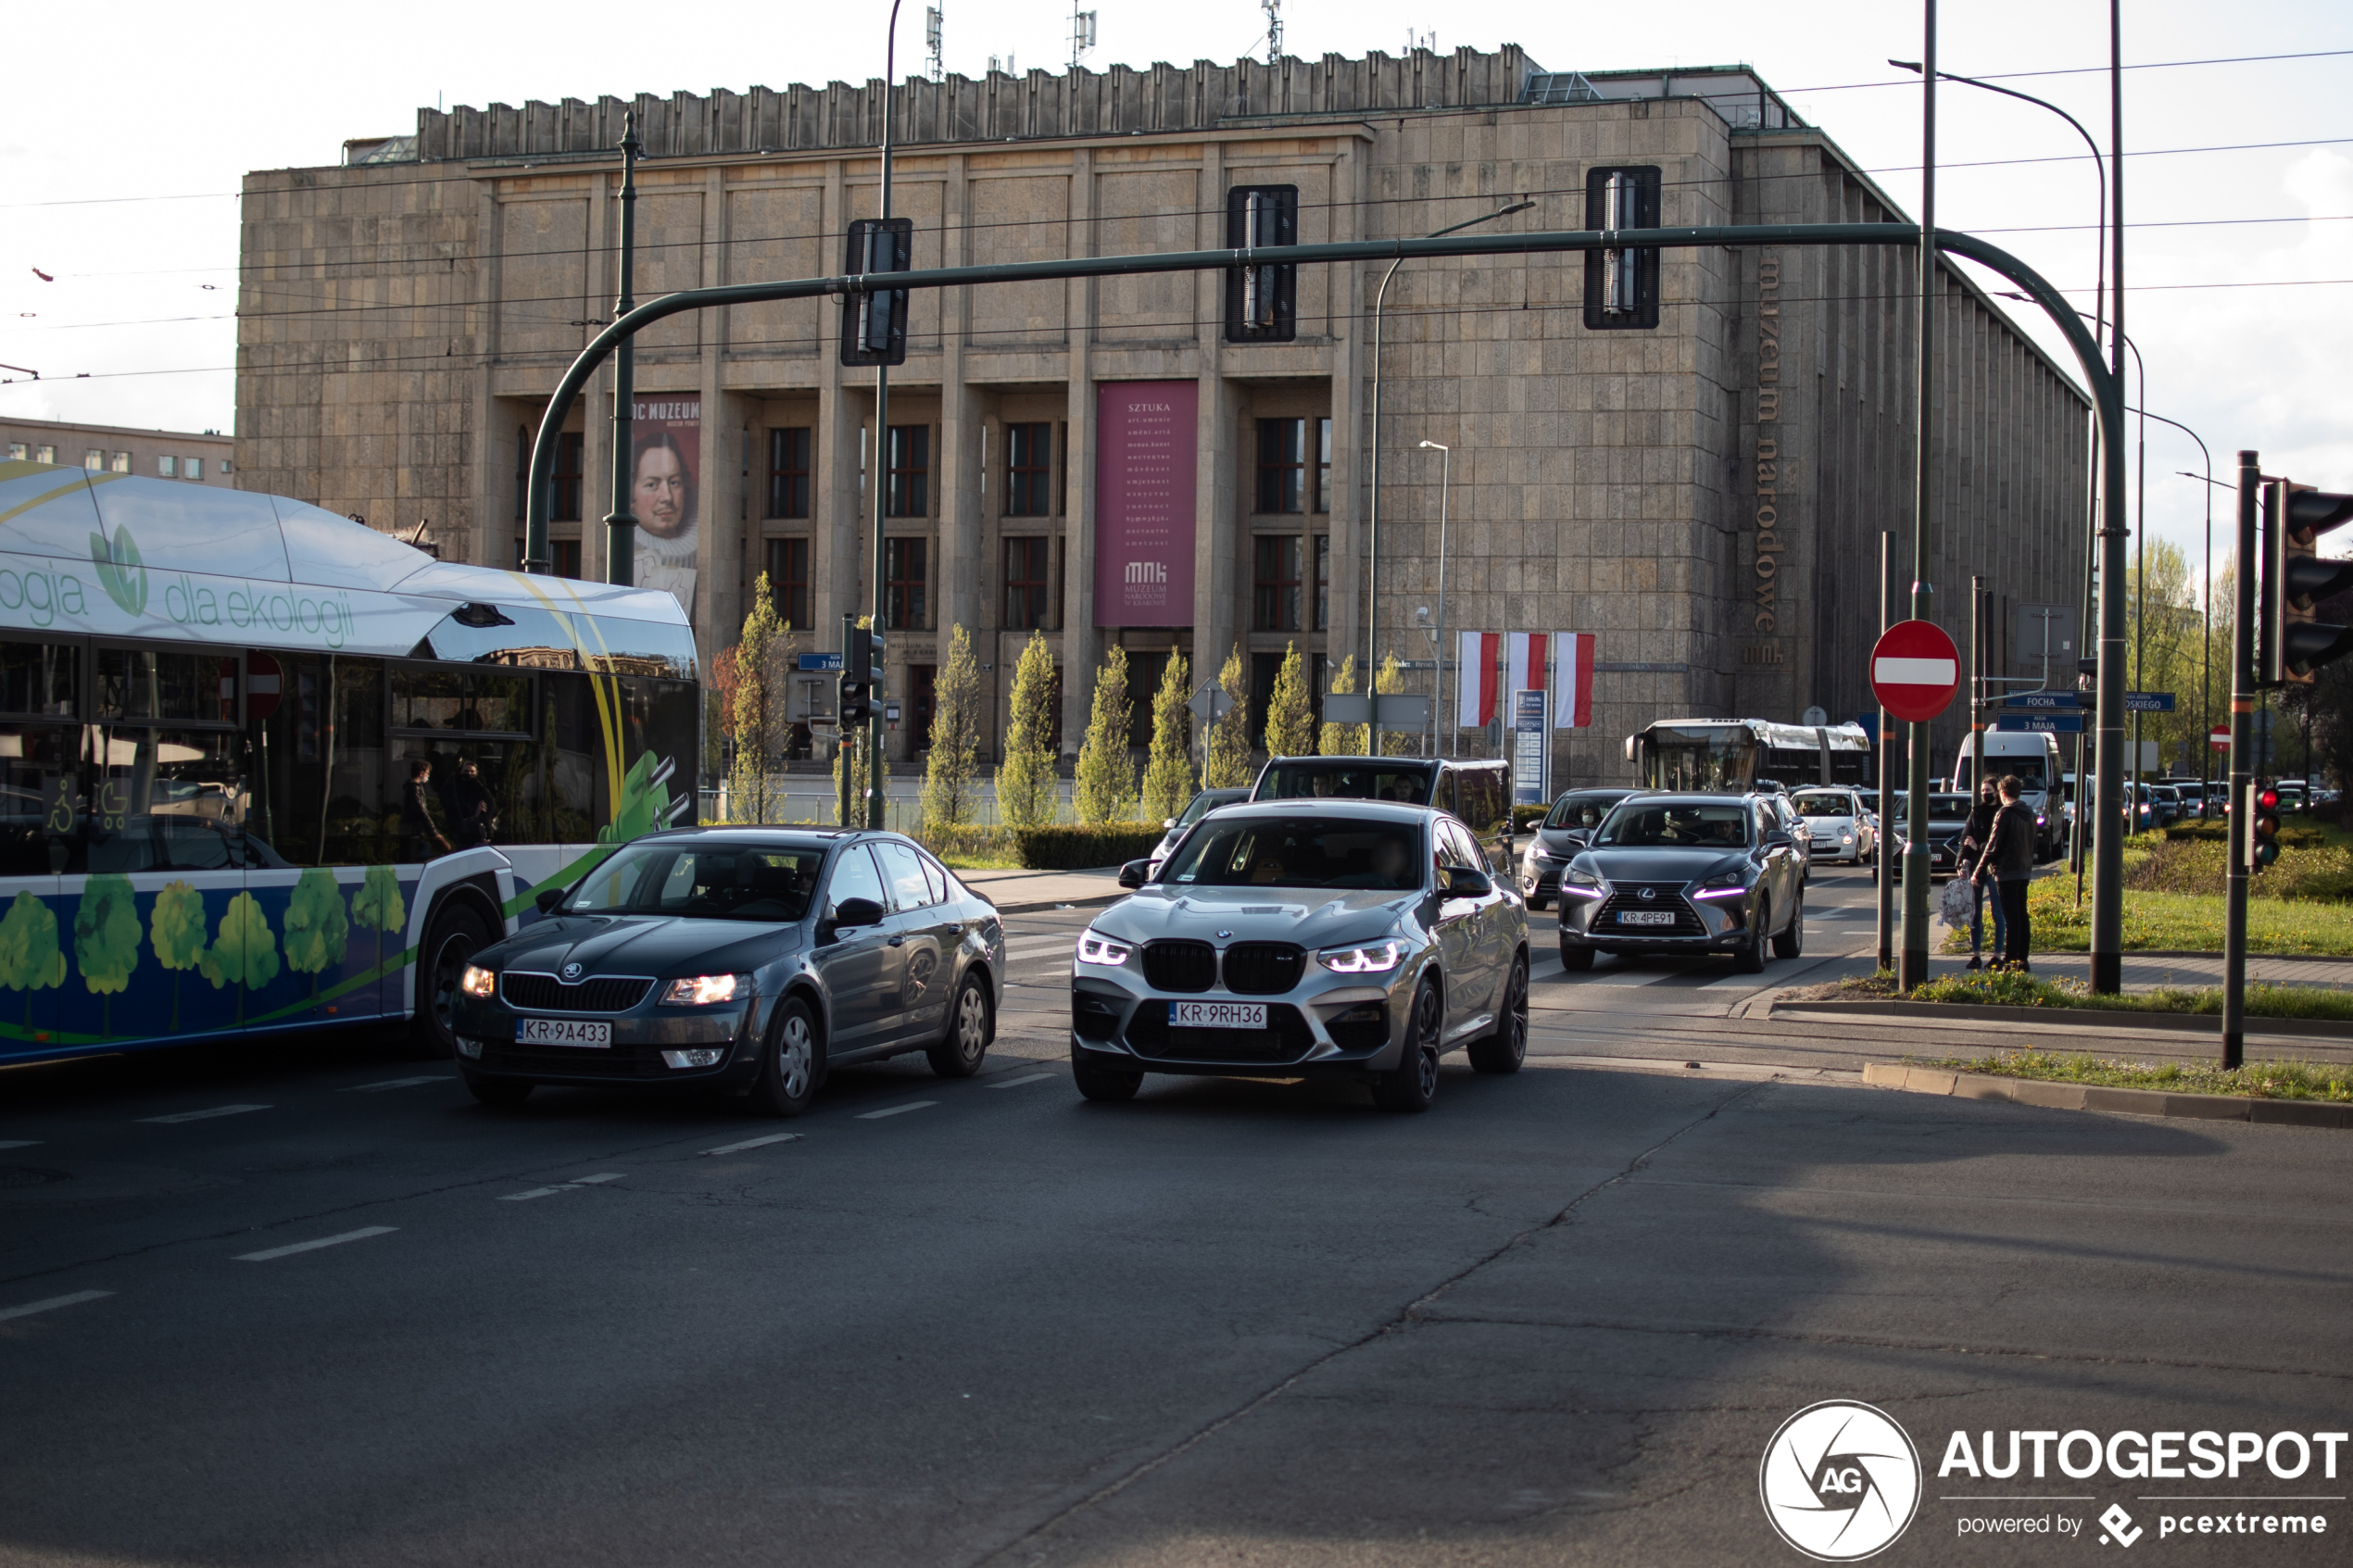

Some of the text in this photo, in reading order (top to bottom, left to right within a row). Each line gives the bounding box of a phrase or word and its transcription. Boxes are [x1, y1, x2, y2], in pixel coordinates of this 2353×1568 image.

[648, 402, 699, 420] MUZEUM
[1128, 404, 1171, 412] SZTUKA
[1755, 256, 1785, 633] muzeum narodowe
[1125, 584, 1167, 593] MUZEUM
[165, 573, 222, 626] dla
[227, 581, 355, 648] ekologii
[822, 659, 844, 669] 3 MAJ
[2026, 697, 2056, 706] FOCHA
[1623, 912, 1637, 922] KR
[1641, 912, 1671, 923] 4PE91
[1180, 1004, 1202, 1022] KR
[1209, 1005, 1263, 1023] 9RH36
[525, 1021, 549, 1039] KR
[555, 1022, 608, 1042] 9A433
